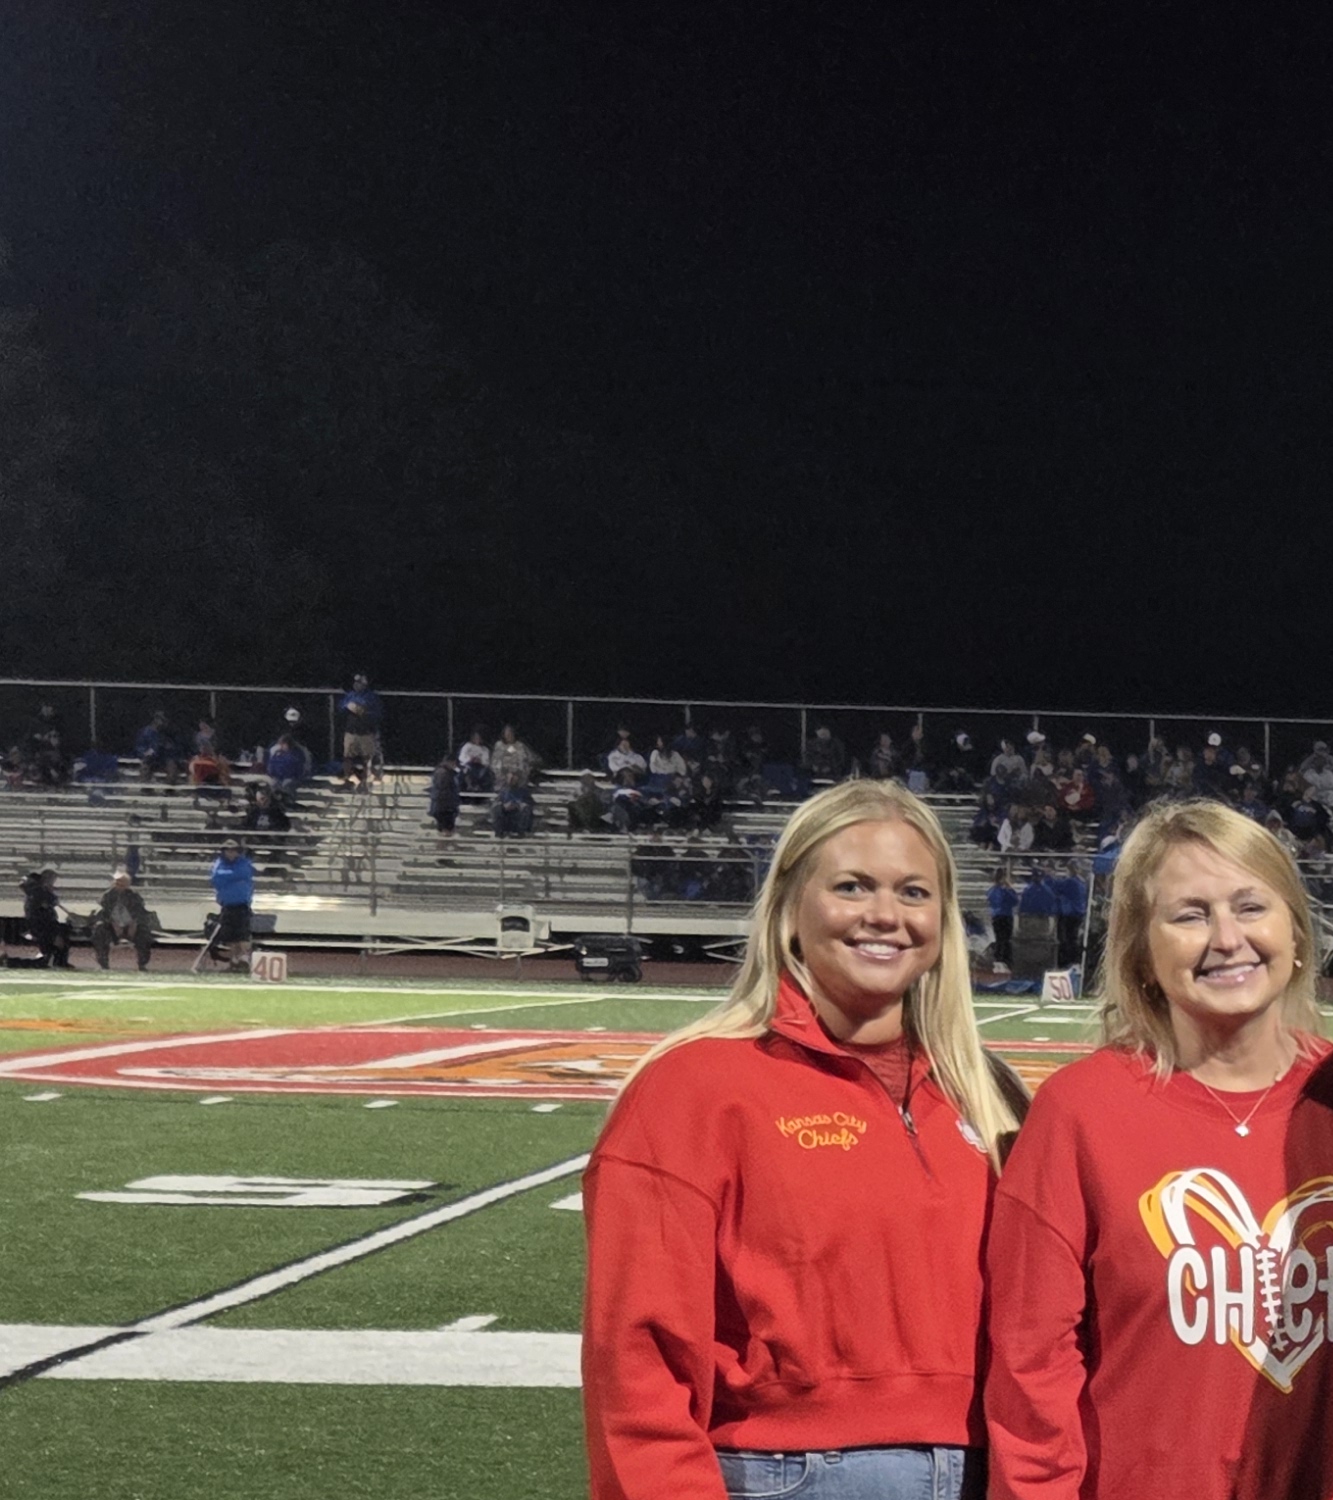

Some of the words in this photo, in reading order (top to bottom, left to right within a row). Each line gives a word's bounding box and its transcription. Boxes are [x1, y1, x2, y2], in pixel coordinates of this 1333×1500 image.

[253, 955, 284, 981] 40
[1048, 975, 1071, 1000] 50
[775, 1113, 832, 1138] Kansas
[833, 1111, 867, 1134] City
[798, 1128, 859, 1151] Chiefs
